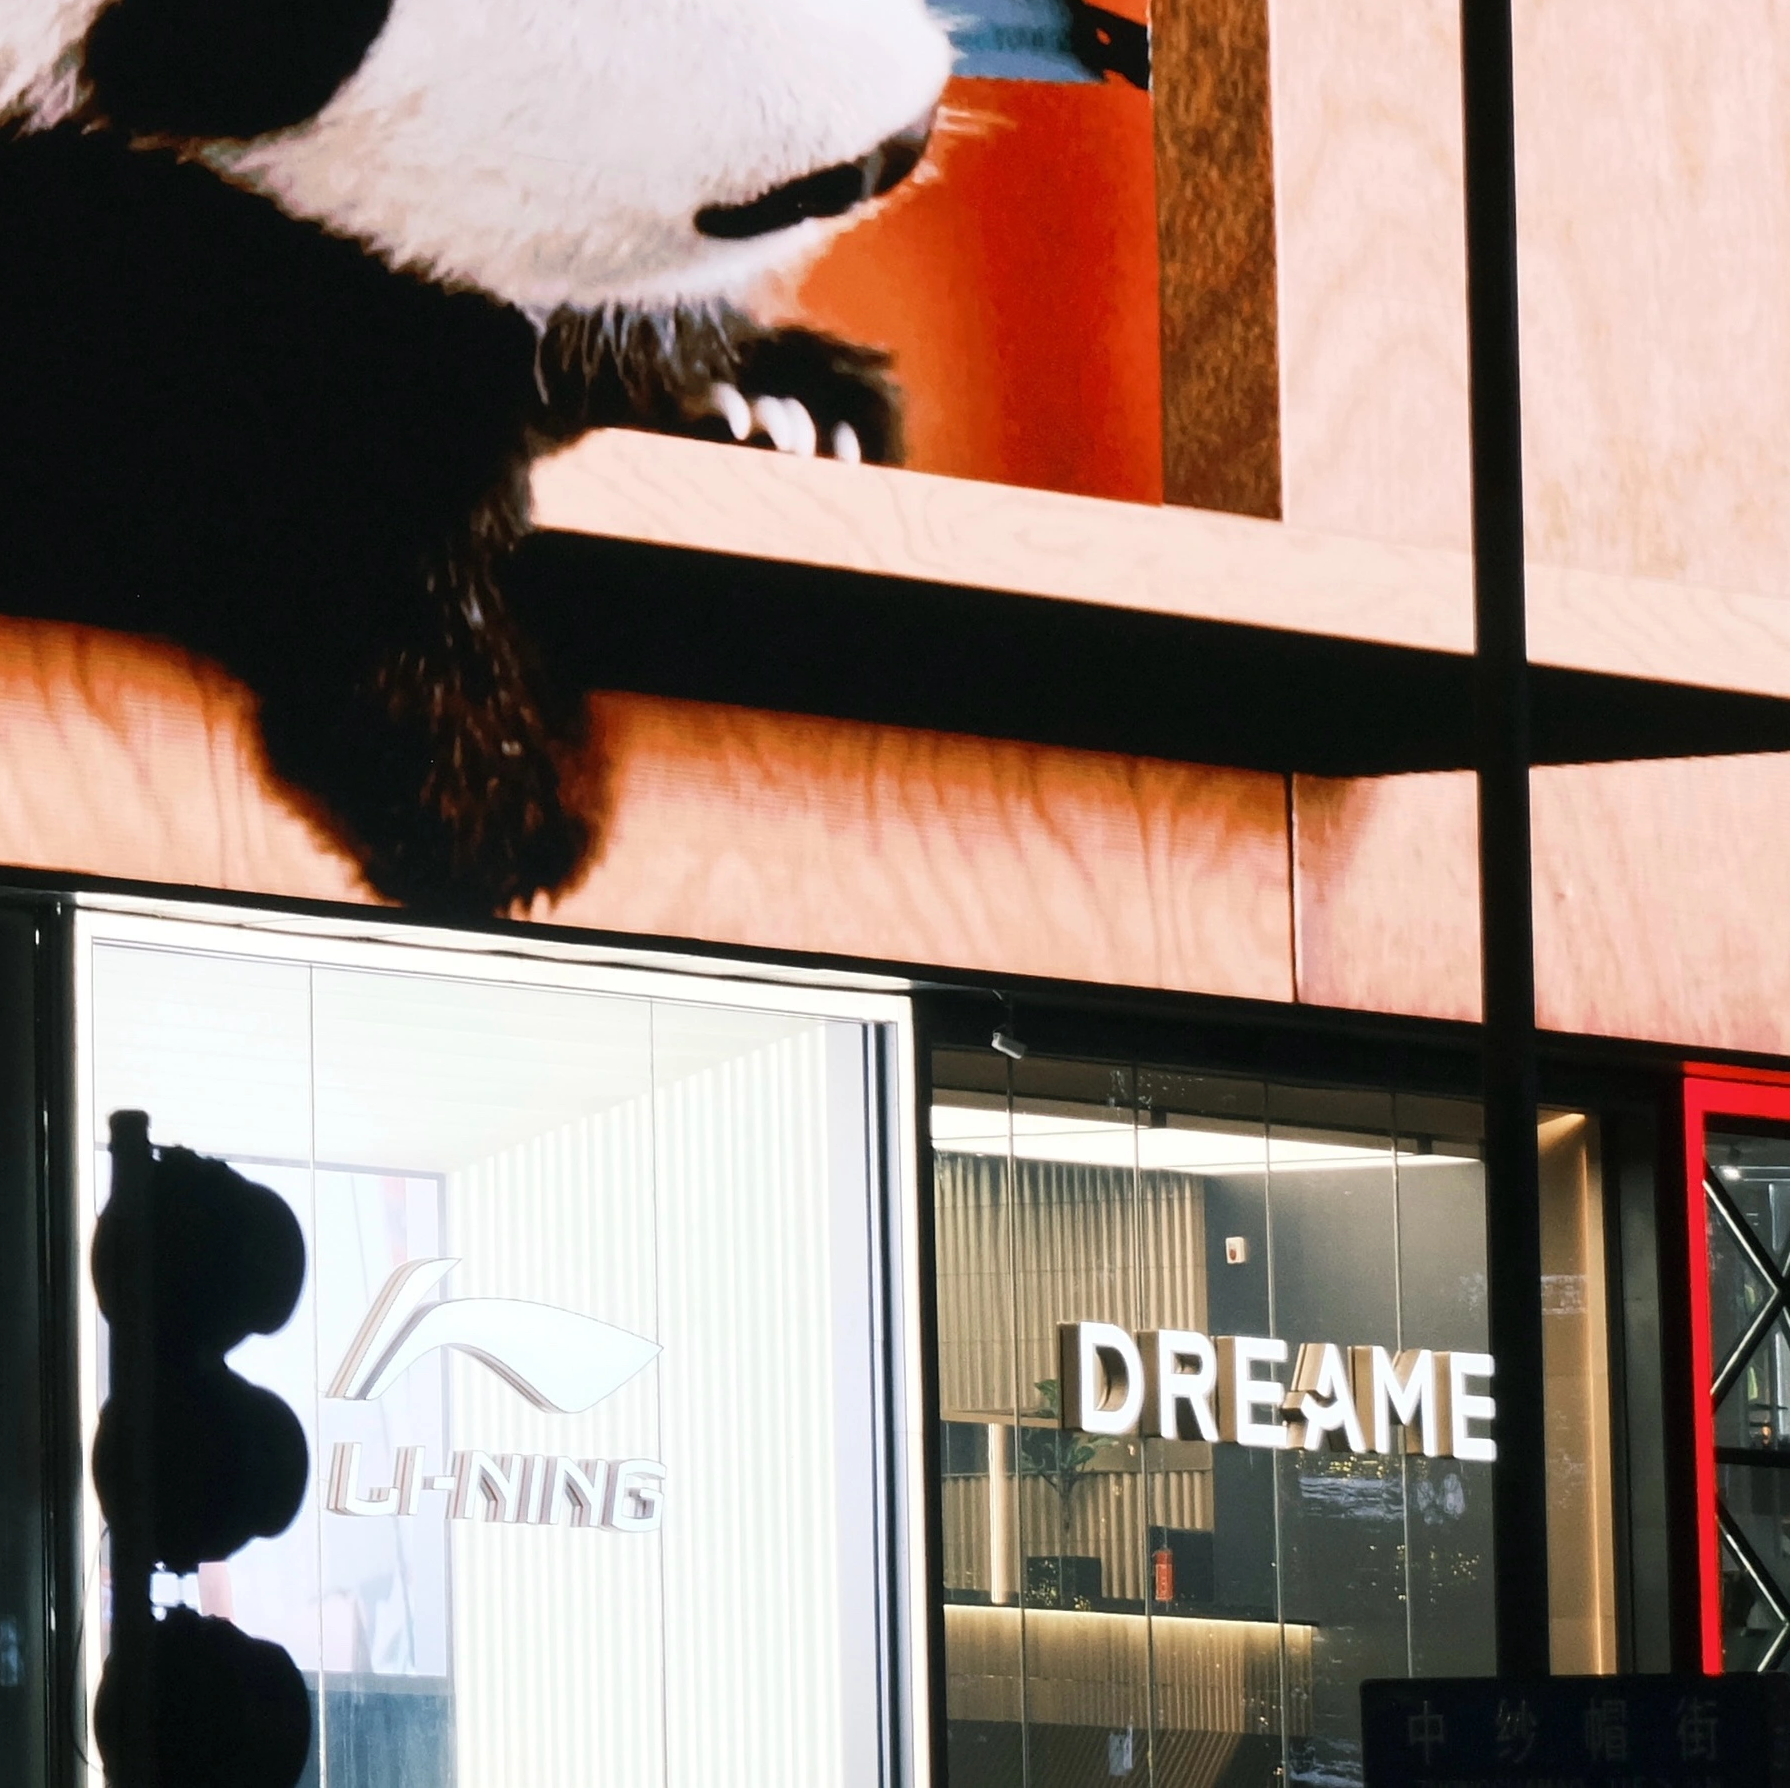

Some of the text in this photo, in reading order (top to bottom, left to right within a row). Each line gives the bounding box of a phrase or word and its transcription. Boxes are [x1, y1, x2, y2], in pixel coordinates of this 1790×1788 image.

[1073, 1320, 1497, 1462] DREAME
[329, 1441, 667, 1534] LI-NING
[1407, 1697, 1719, 1765] 中纱帽街
